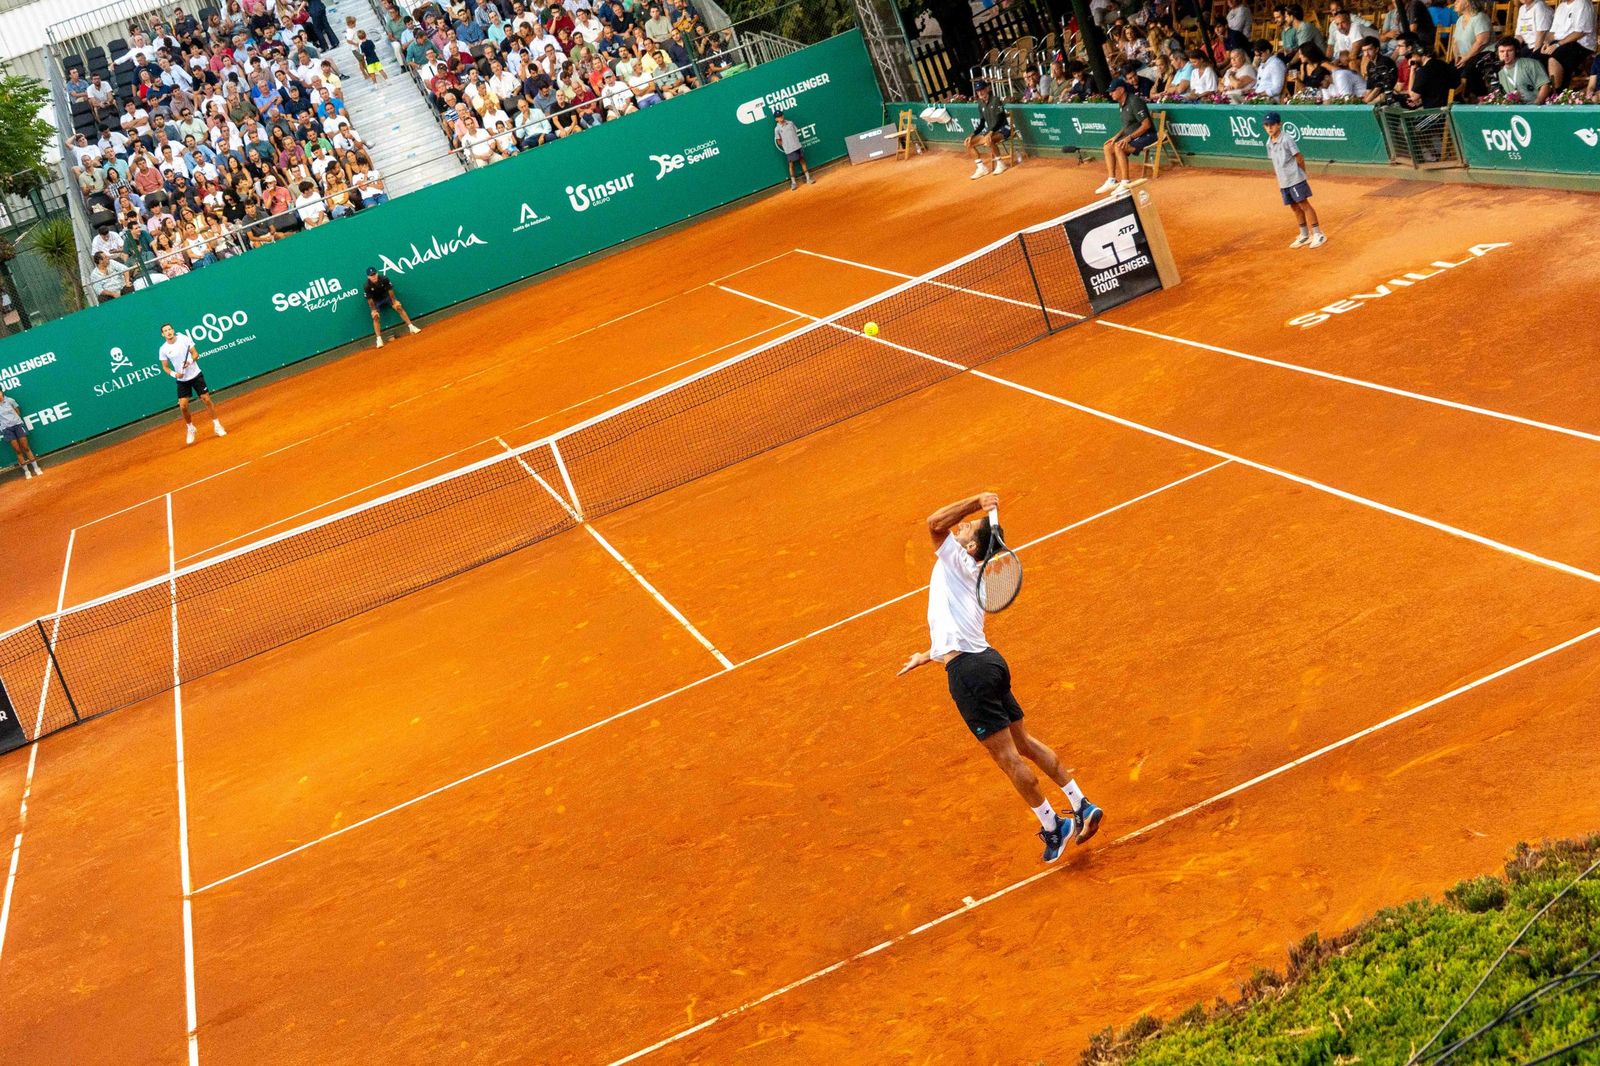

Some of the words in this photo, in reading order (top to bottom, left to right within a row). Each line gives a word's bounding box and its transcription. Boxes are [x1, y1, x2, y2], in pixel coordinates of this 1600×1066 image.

[765, 72, 831, 105] CHALLENGER
[768, 97, 798, 115] TOUR
[1229, 116, 1260, 138] ABC
[1300, 125, 1346, 137] solocanarias
[684, 139, 717, 155] Diputación
[687, 147, 720, 165] Sevilla
[1508, 152, 1522, 160] ESS
[592, 196, 611, 207] GRUPO
[1118, 224, 1135, 236] ATP
[378, 225, 488, 276] Andalucía
[1090, 255, 1150, 287] CHALLENGER
[272, 277, 342, 312] Sevilla
[1093, 278, 1120, 296] TOUR
[1288, 242, 1512, 328] SEVILLA
[0, 351, 57, 381] ALLENGER
[93, 363, 162, 397] SCALPERS
